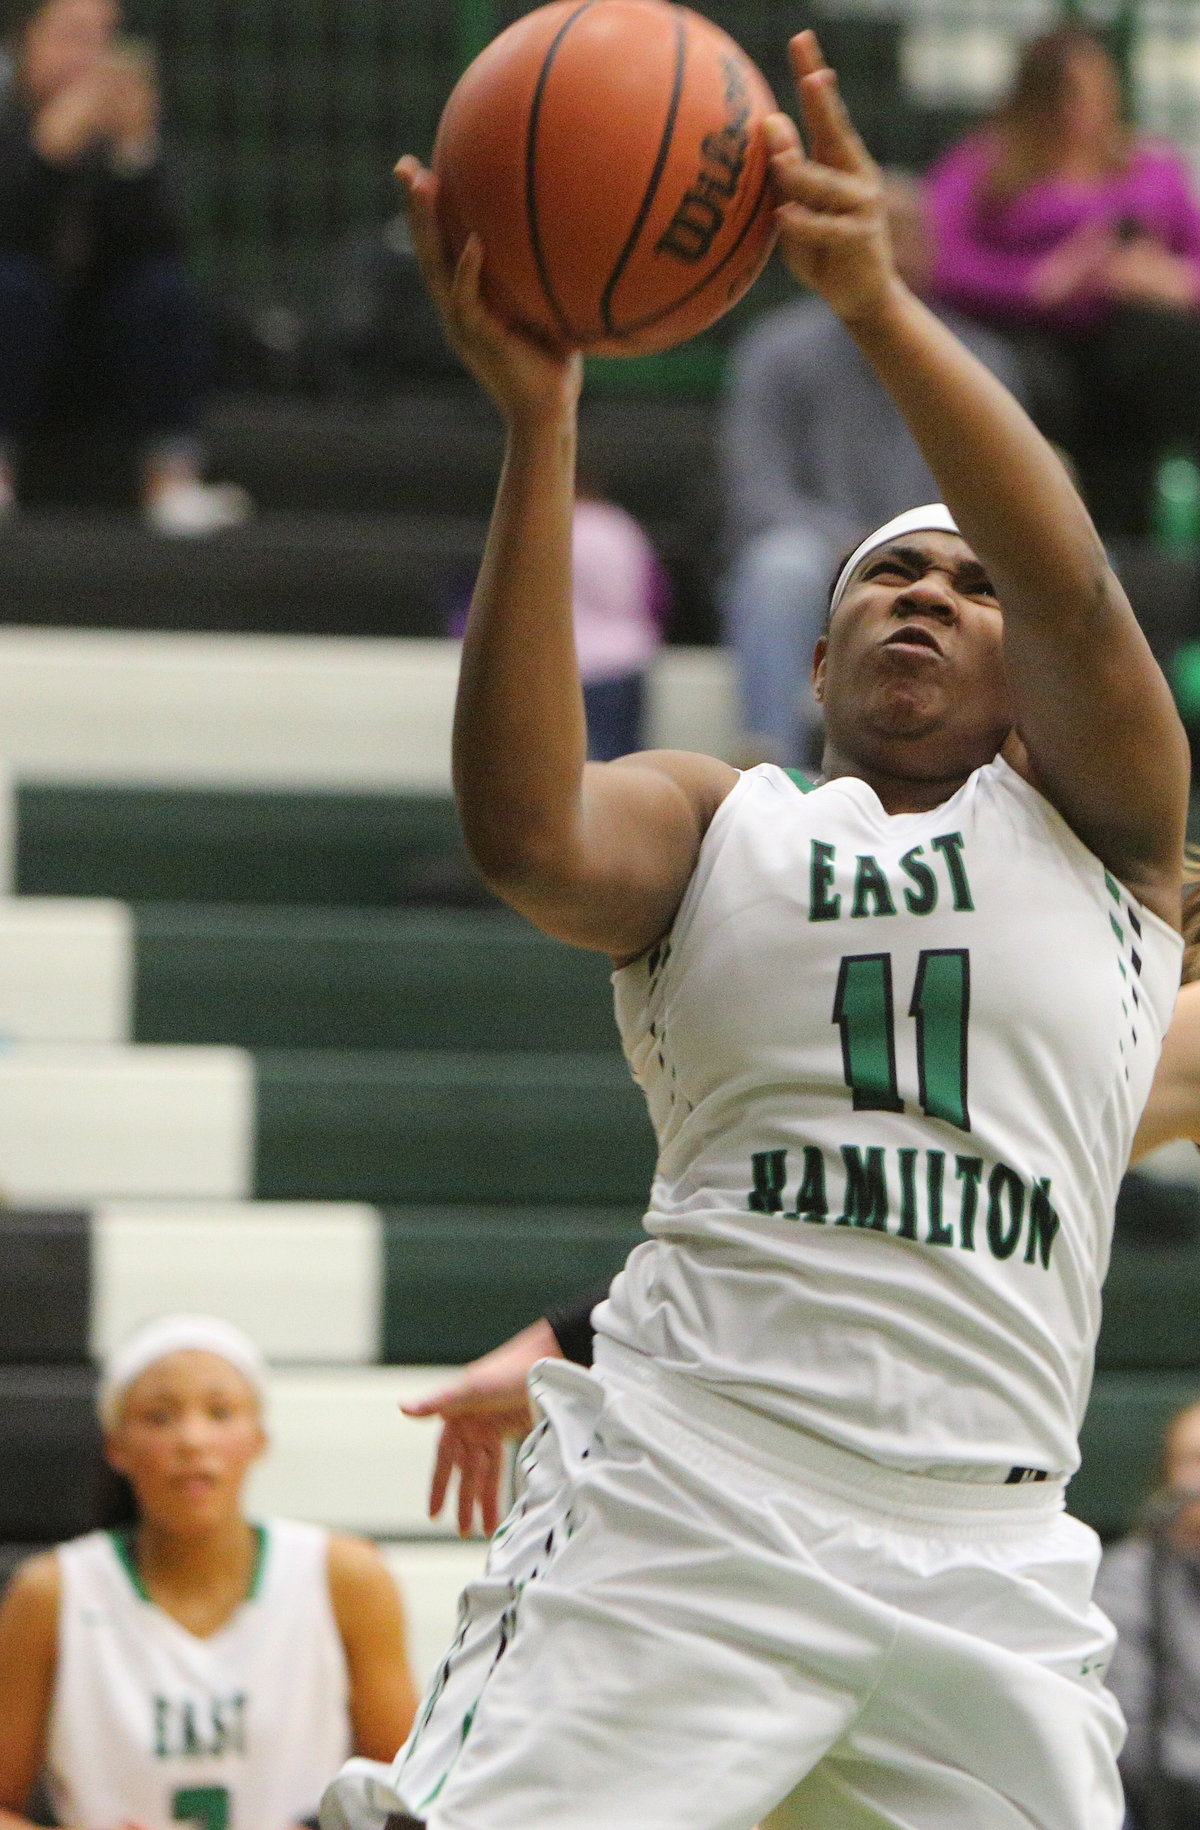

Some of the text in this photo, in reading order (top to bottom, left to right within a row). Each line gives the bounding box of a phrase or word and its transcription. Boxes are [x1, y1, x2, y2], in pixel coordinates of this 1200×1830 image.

[809, 831, 975, 922] EAST
[833, 948, 970, 1133] 11
[748, 1144, 1060, 1271] HAMILTON
